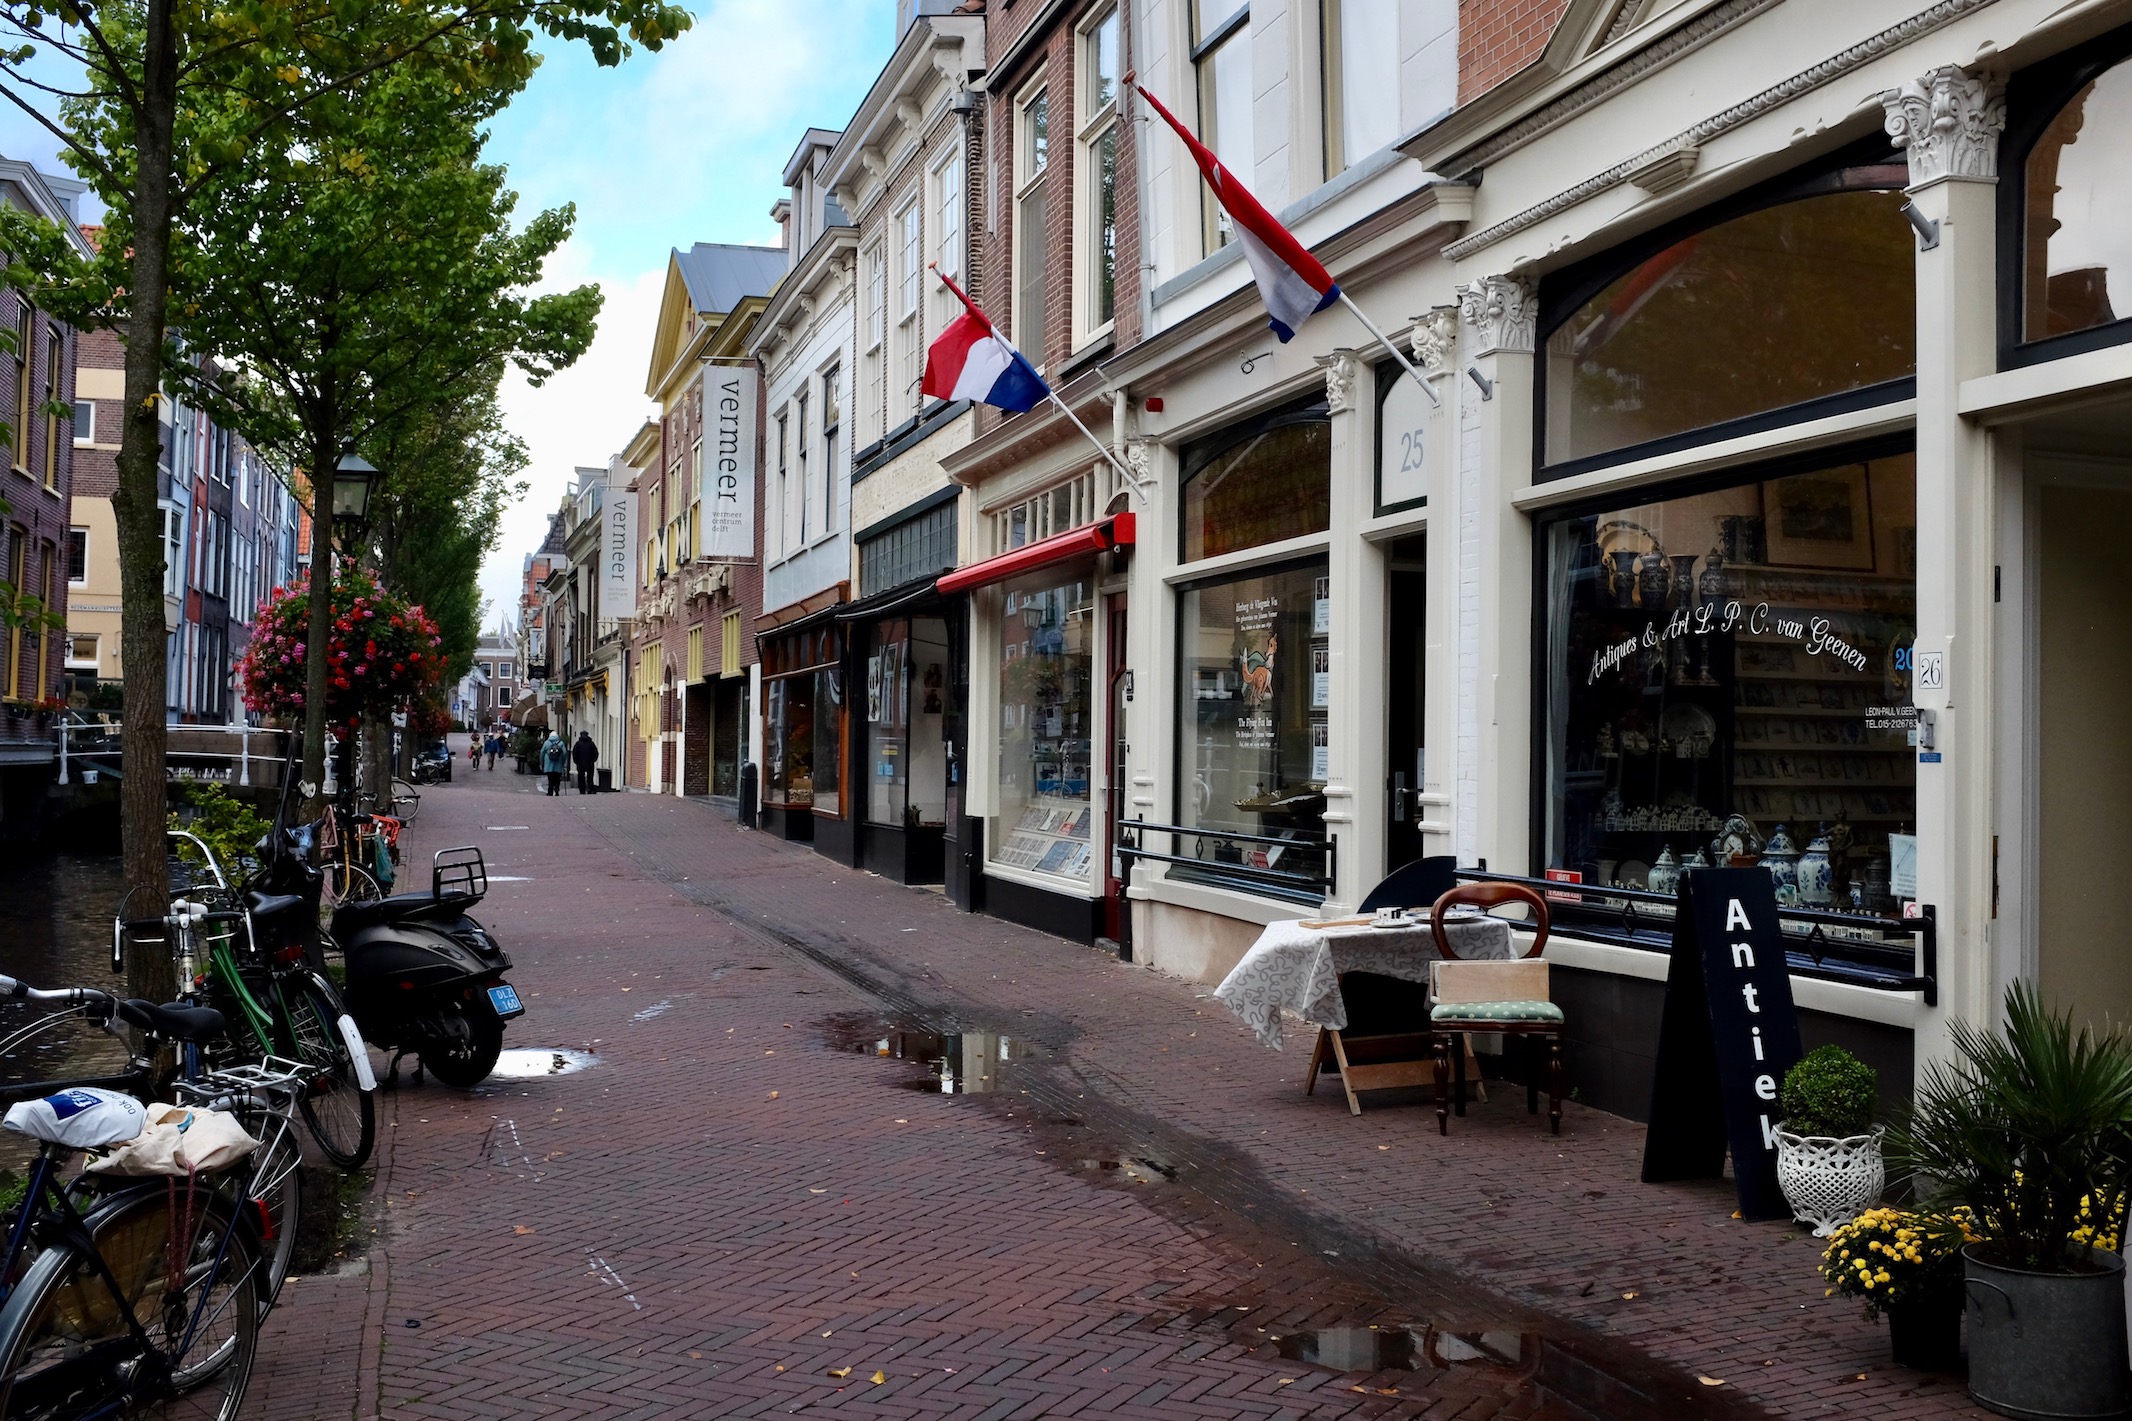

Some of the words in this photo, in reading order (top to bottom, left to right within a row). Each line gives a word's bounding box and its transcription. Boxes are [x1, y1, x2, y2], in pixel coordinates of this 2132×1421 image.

[718, 379, 740, 503] vermeer
[1400, 429, 1424, 473] 25
[712, 511, 743, 519] vermeer
[611, 500, 626, 582] vermeer
[1587, 636, 1637, 686] Antiques
[1642, 621, 1658, 648] &
[1662, 609, 1690, 640] Art
[1695, 602, 1714, 634] L.
[1721, 601, 1743, 632] P.
[1750, 602, 1770, 635] C.
[1777, 619, 1803, 640] van
[1806, 616, 1867, 672] Geenen
[1920, 657, 1941, 686] 26
[1865, 706, 1896, 717] LEON-PAUL
[496, 988, 514, 999] DLZ
[1725, 897, 1780, 1151] Antiek
